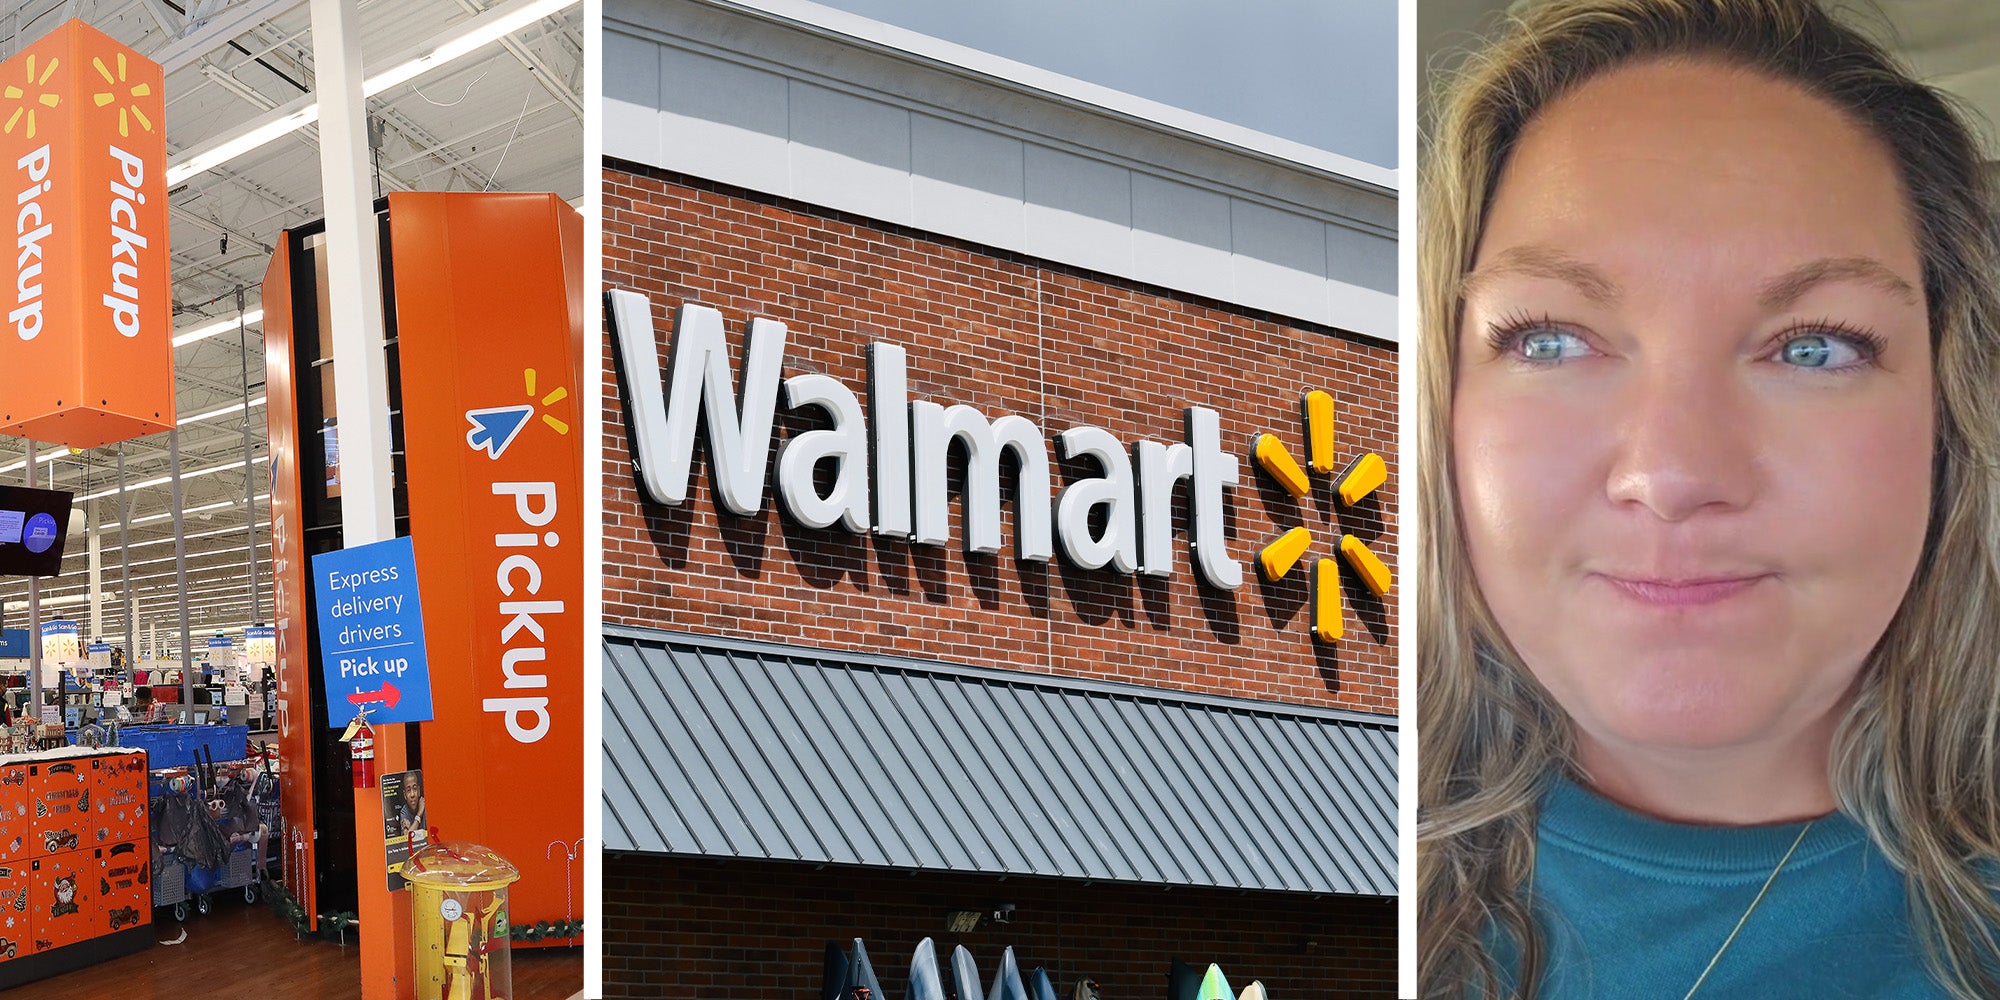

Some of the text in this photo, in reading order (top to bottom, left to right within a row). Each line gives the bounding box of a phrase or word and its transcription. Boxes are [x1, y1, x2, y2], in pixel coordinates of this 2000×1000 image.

[8, 144, 53, 341] Pickup
[103, 145, 148, 338] Pickup
[608, 288, 1242, 590] Walmart
[329, 566, 399, 592] Express
[331, 594, 403, 618] delivery
[483, 482, 564, 743] Pickup
[338, 623, 402, 645] drivers
[340, 656, 408, 678] Pick up
